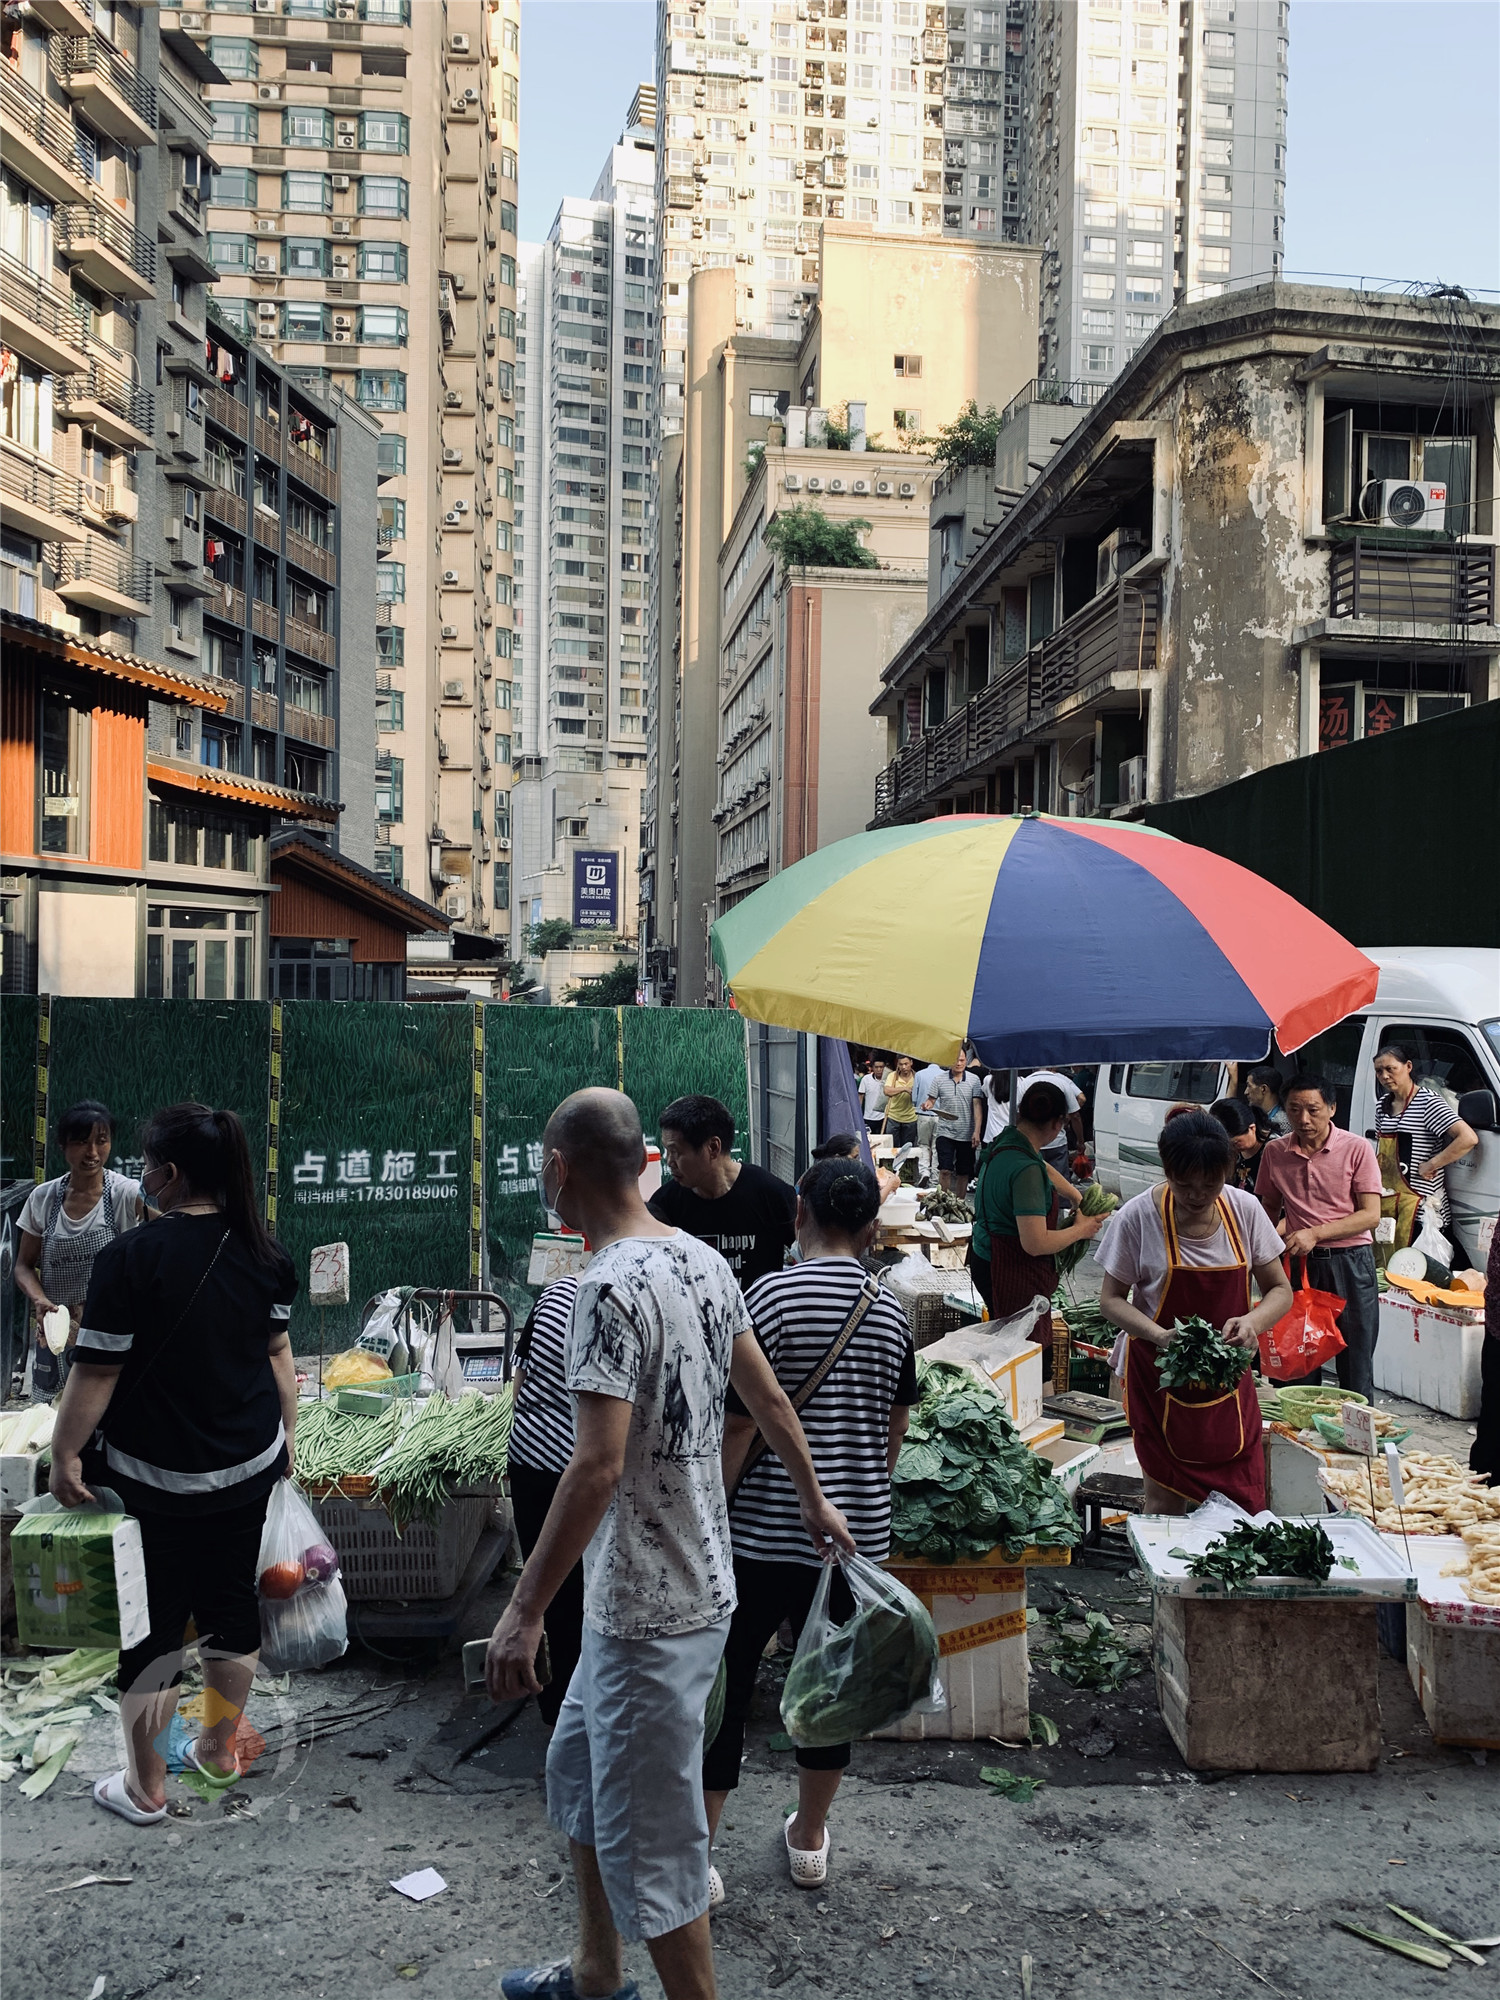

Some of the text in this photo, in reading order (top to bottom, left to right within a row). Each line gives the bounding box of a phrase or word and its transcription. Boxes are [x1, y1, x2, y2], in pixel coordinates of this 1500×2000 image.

[1319, 696, 1349, 750] 汤
[580, 887, 611, 896] 美奥口腔
[293, 1149, 458, 1184] 占道施工
[721, 1234, 756, 1250] happy
